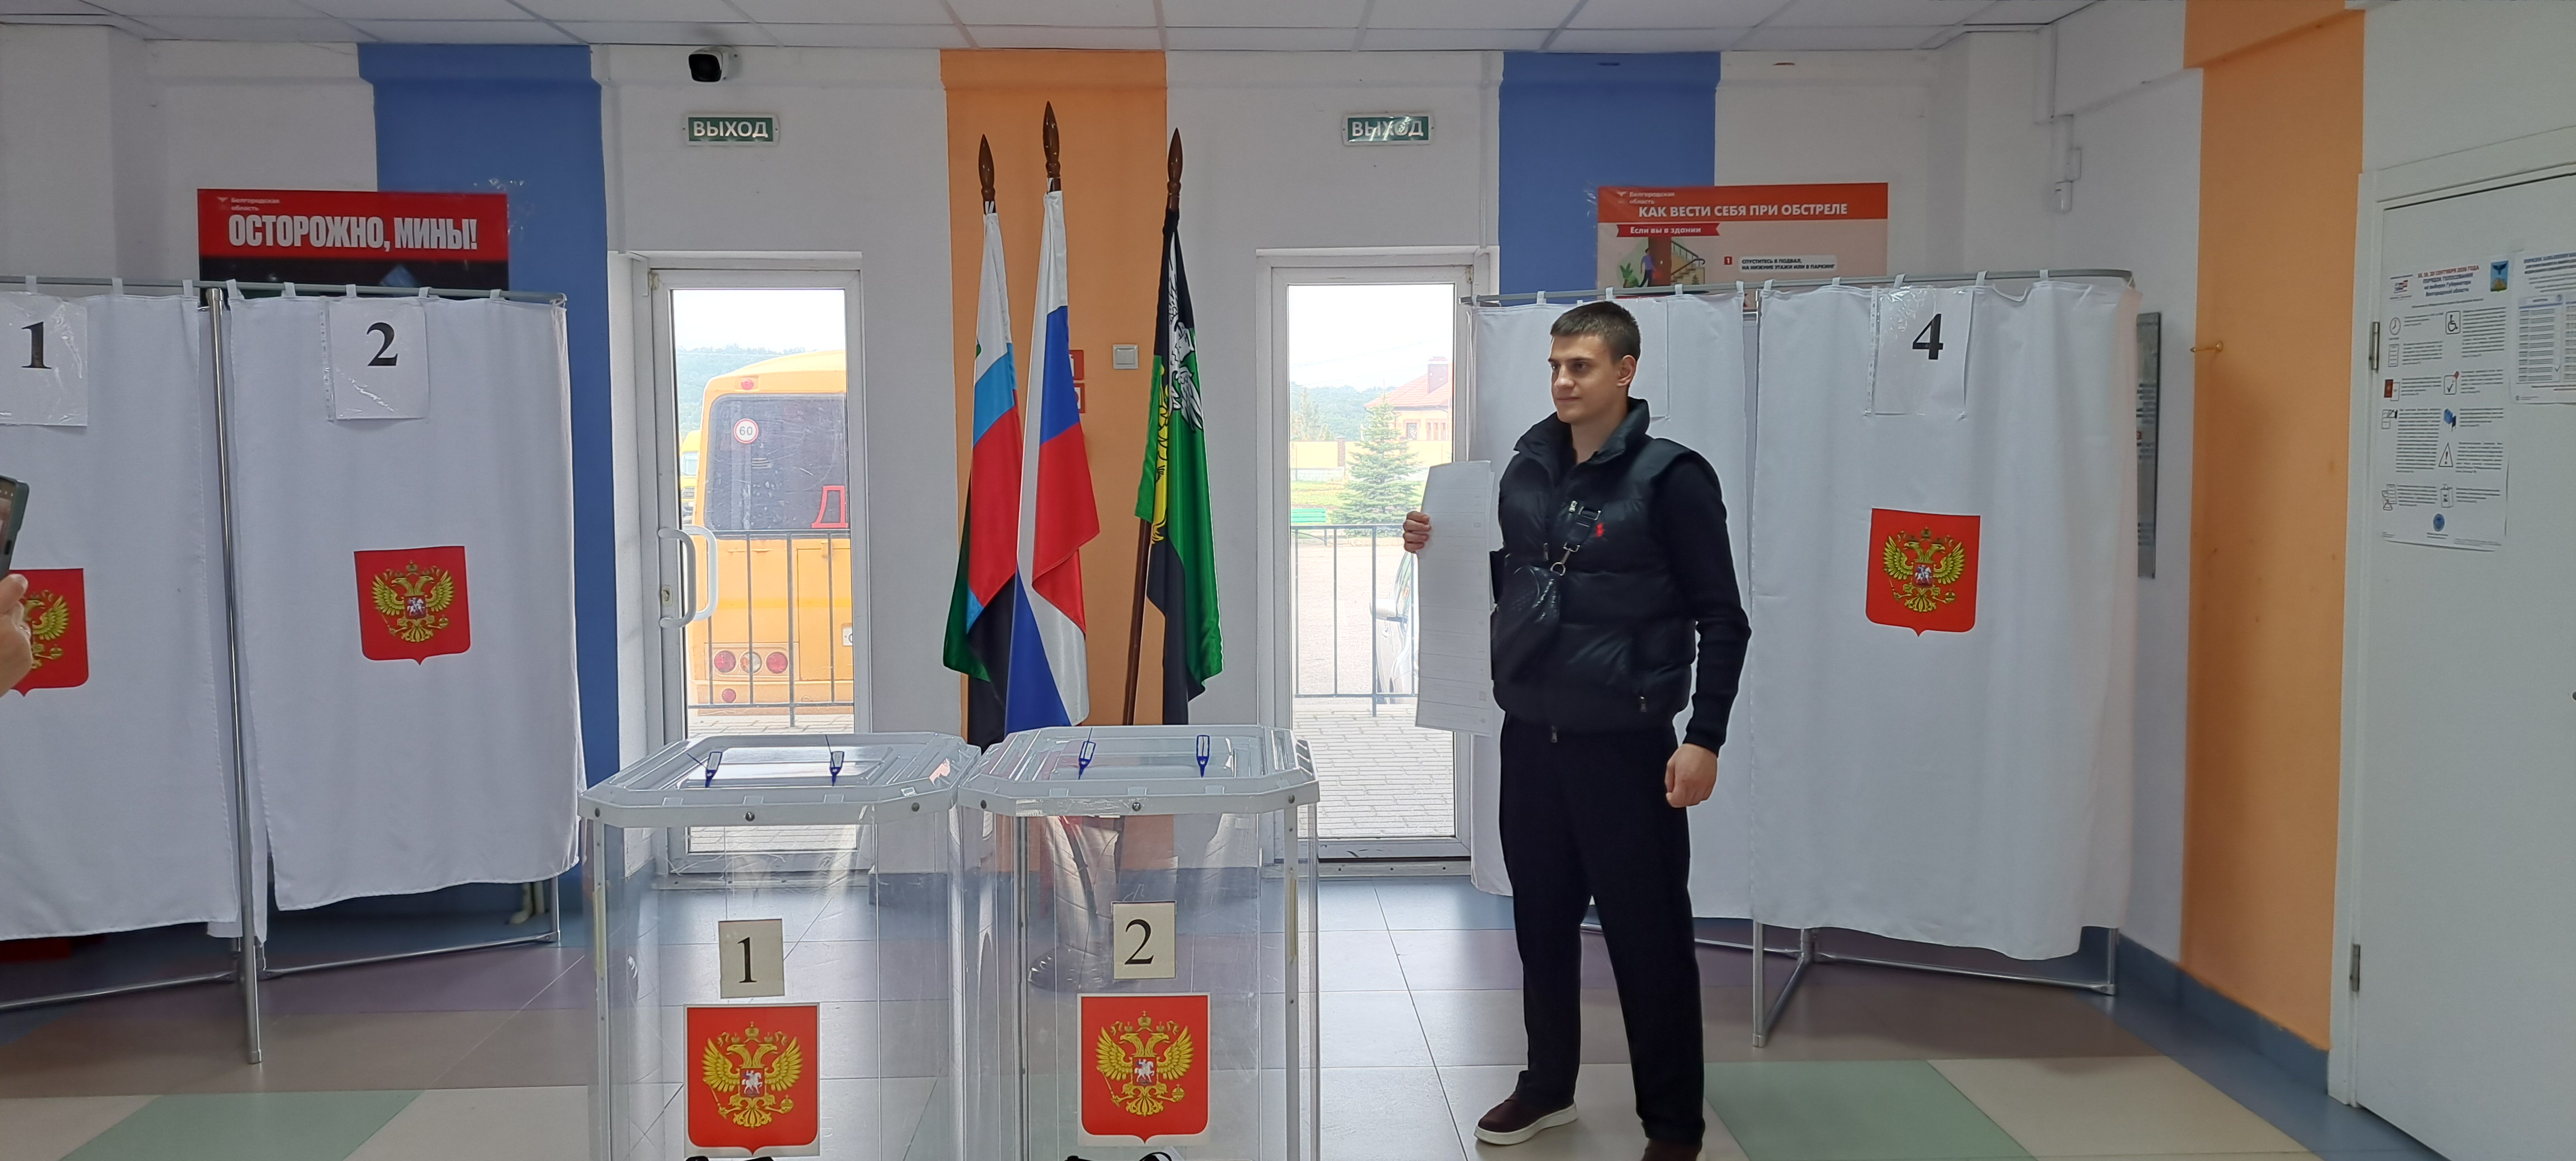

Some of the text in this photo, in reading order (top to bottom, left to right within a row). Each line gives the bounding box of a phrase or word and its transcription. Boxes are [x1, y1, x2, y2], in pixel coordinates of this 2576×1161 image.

[693, 121, 768, 138] ВЫХОД
[1352, 120, 1424, 137] ВЫХОД
[1639, 203, 1848, 217] КАК ВЕСТИ СЕБЯ ПРИ ОБСТРЕЛЕ
[228, 214, 477, 252] ОСТОРОЖНО, МИНЫ!
[21, 321, 52, 369] 1
[366, 322, 398, 366] 2
[1912, 313, 1944, 360] 4
[739, 426, 753, 435] 60
[811, 485, 848, 528] Д
[737, 936, 758, 983] 1
[1124, 919, 1154, 965] 2
